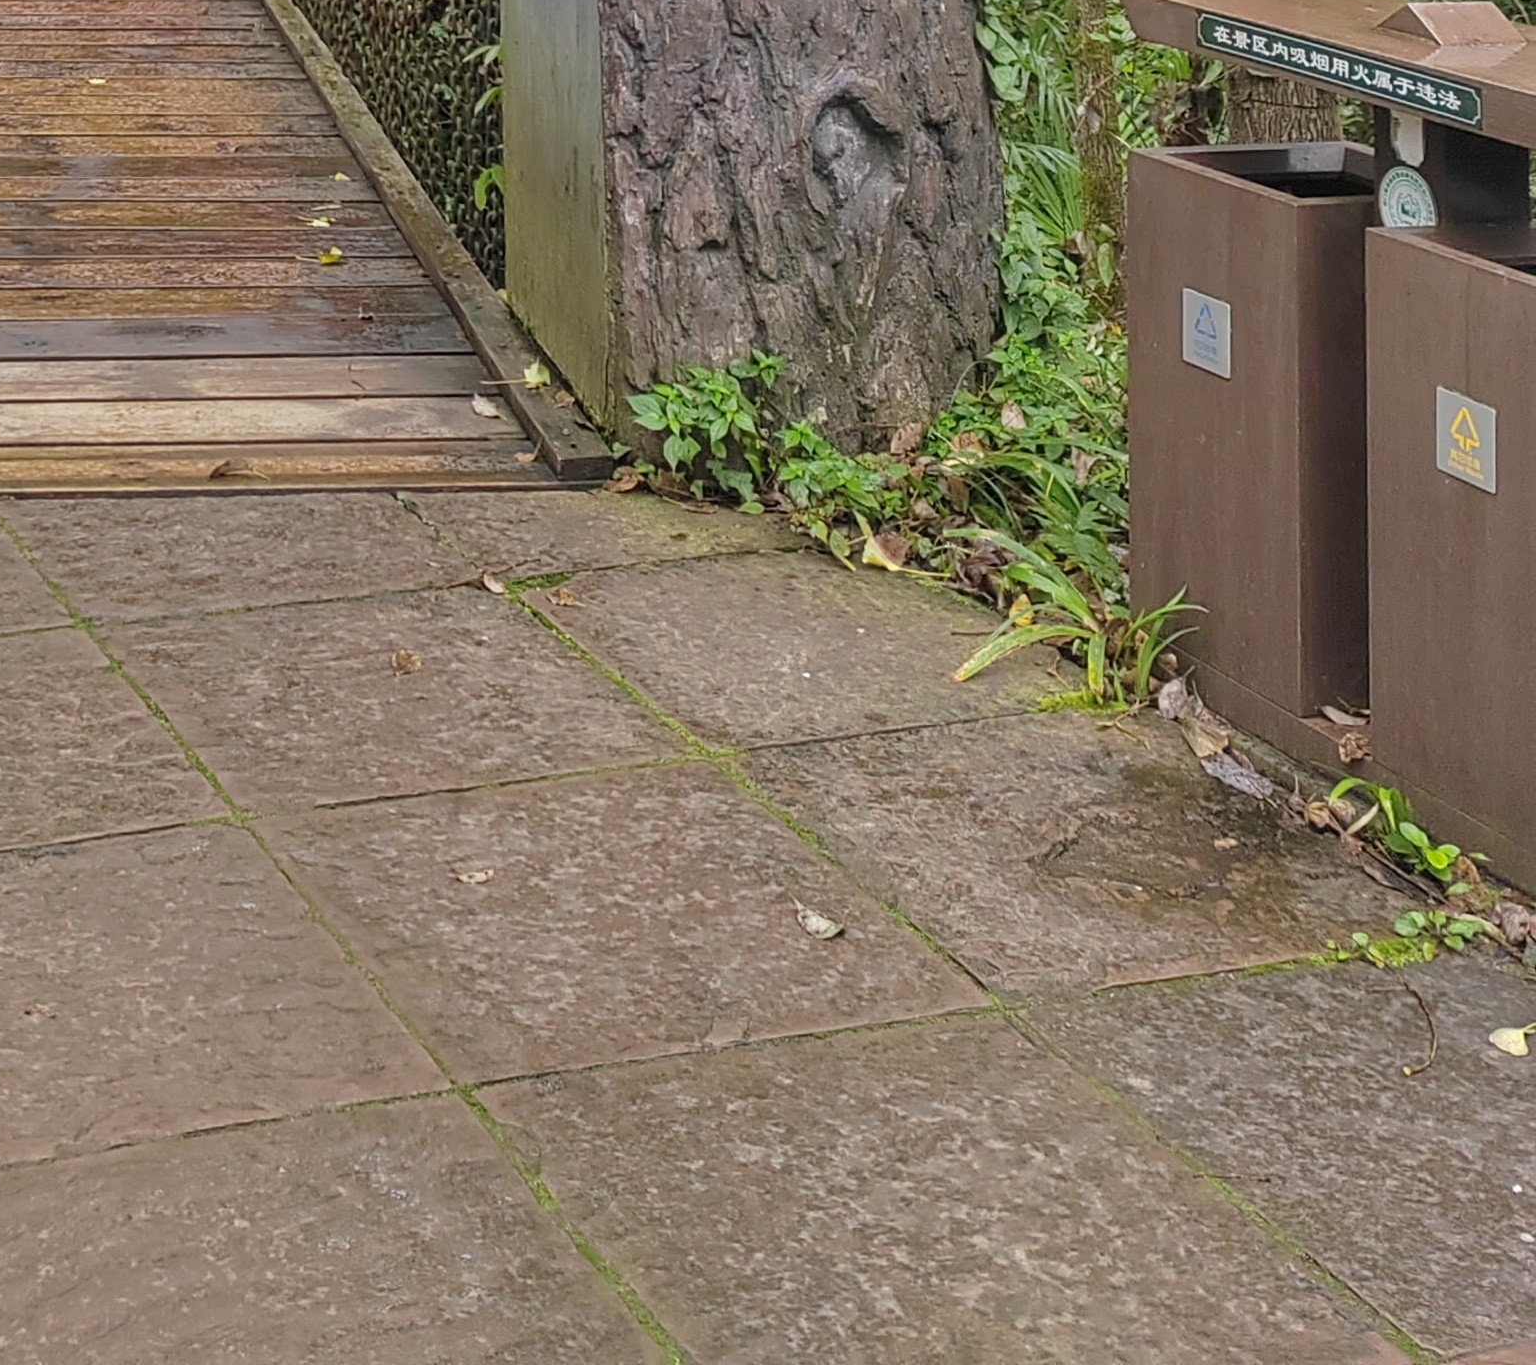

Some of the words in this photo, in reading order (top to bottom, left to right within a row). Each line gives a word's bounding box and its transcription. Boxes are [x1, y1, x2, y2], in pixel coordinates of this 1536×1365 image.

[1213, 24, 1463, 112] 在景区内吸烟用火属于违法
